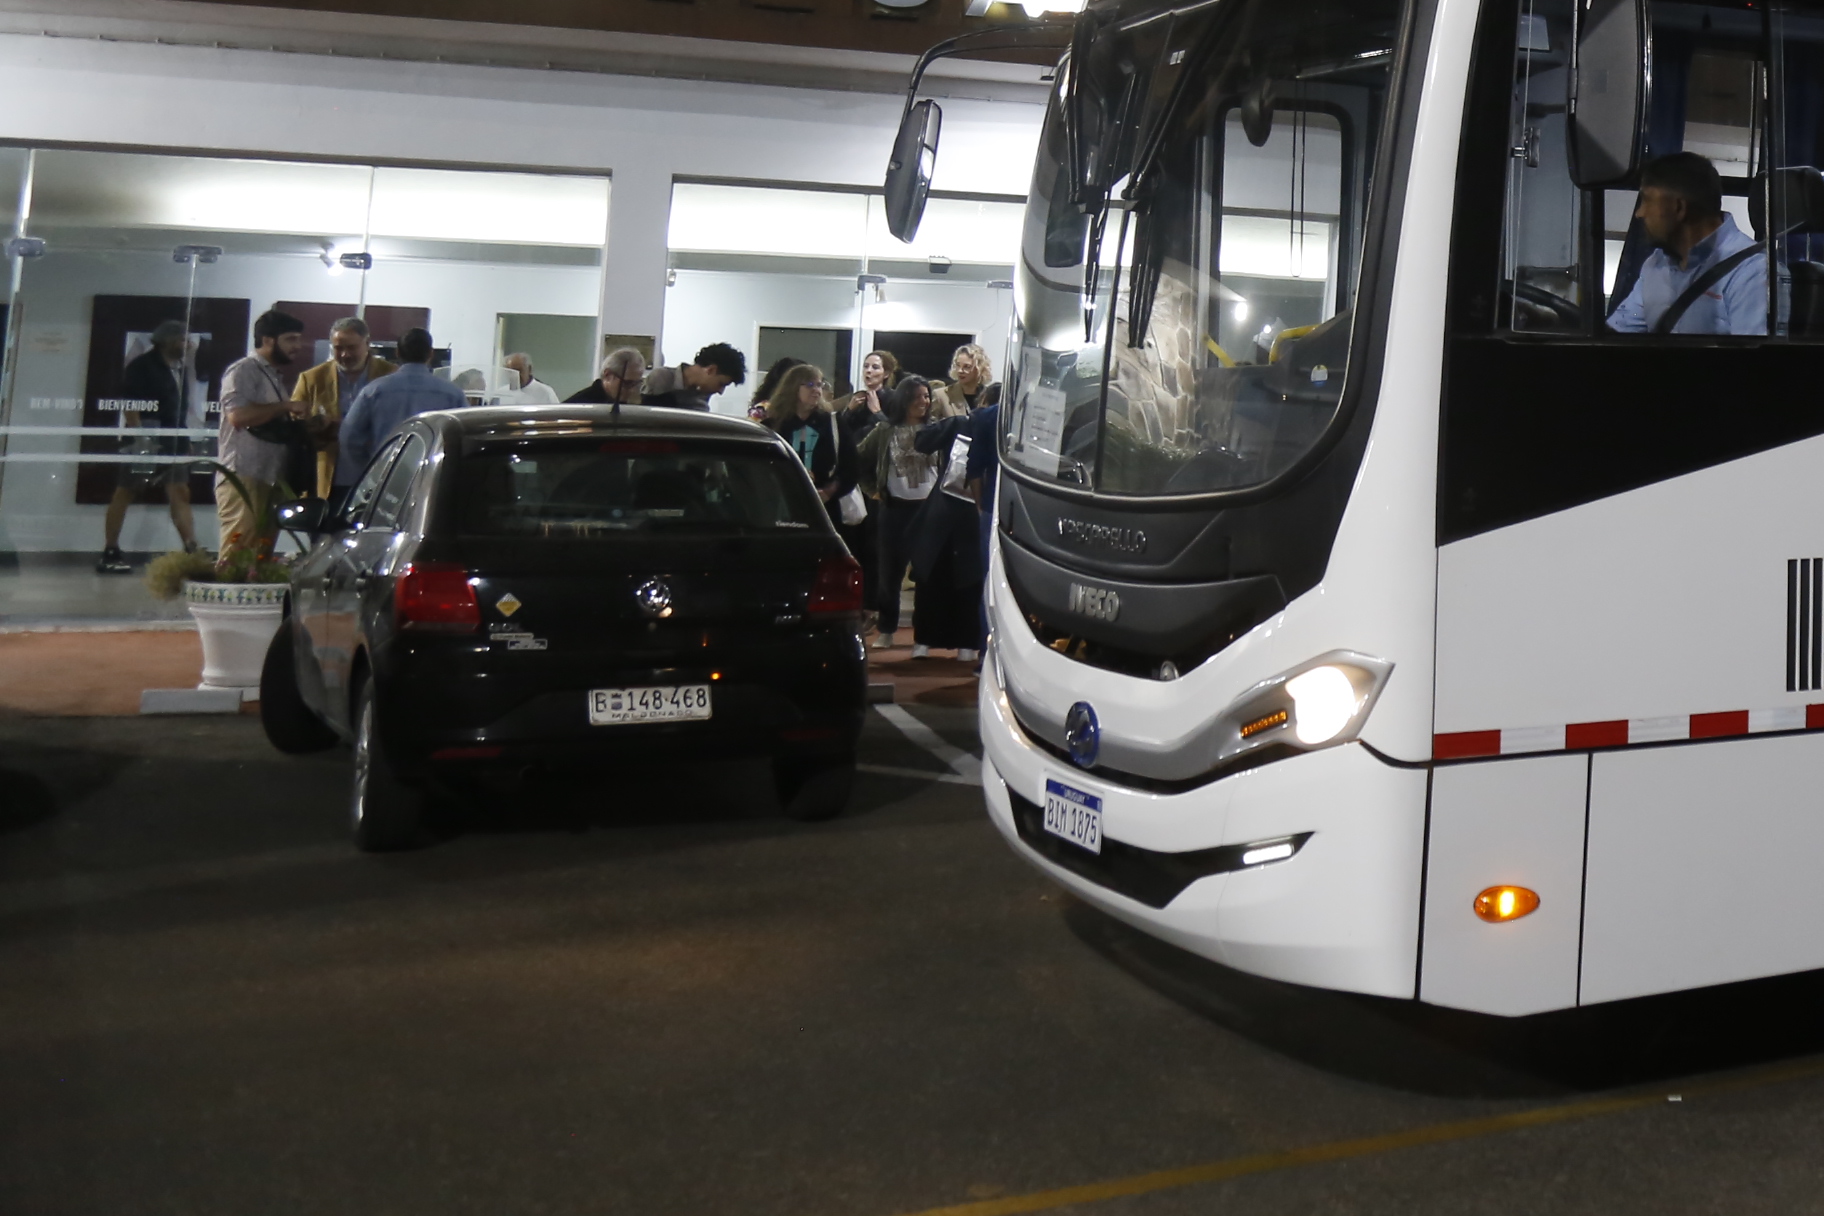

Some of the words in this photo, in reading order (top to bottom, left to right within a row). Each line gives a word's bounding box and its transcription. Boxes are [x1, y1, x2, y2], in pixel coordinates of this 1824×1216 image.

[98, 398, 160, 412] BIENVENIDOS
[1068, 581, 1121, 623] IVECO
[1070, 806, 1097, 844] 1875
